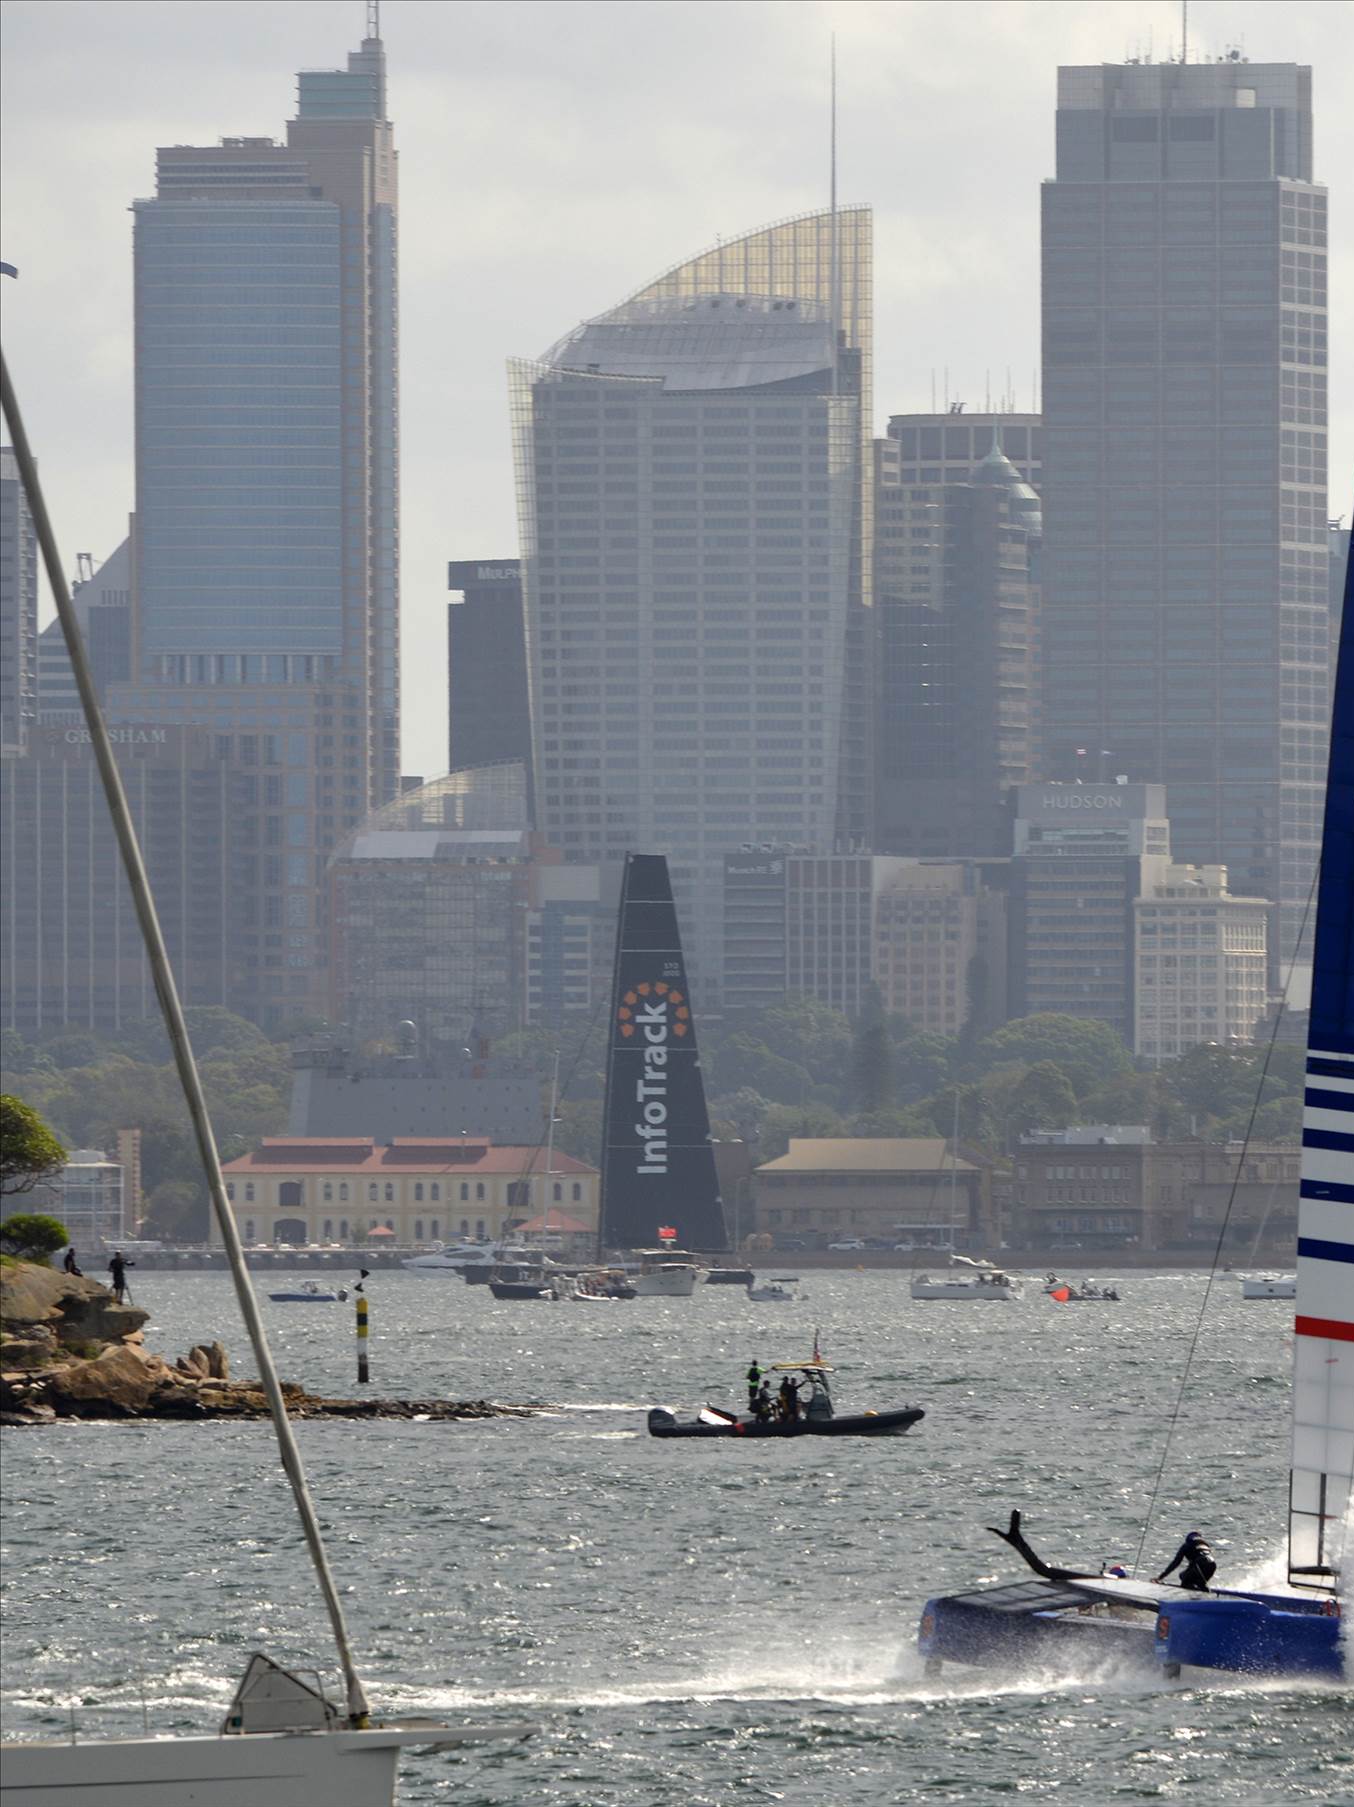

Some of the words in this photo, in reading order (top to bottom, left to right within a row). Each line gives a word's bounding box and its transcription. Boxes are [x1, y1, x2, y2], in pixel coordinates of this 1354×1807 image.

[64, 729, 167, 744] GRSHAM
[1043, 795, 1122, 809] HUDSON
[635, 1001, 667, 1174] InfoTrack
